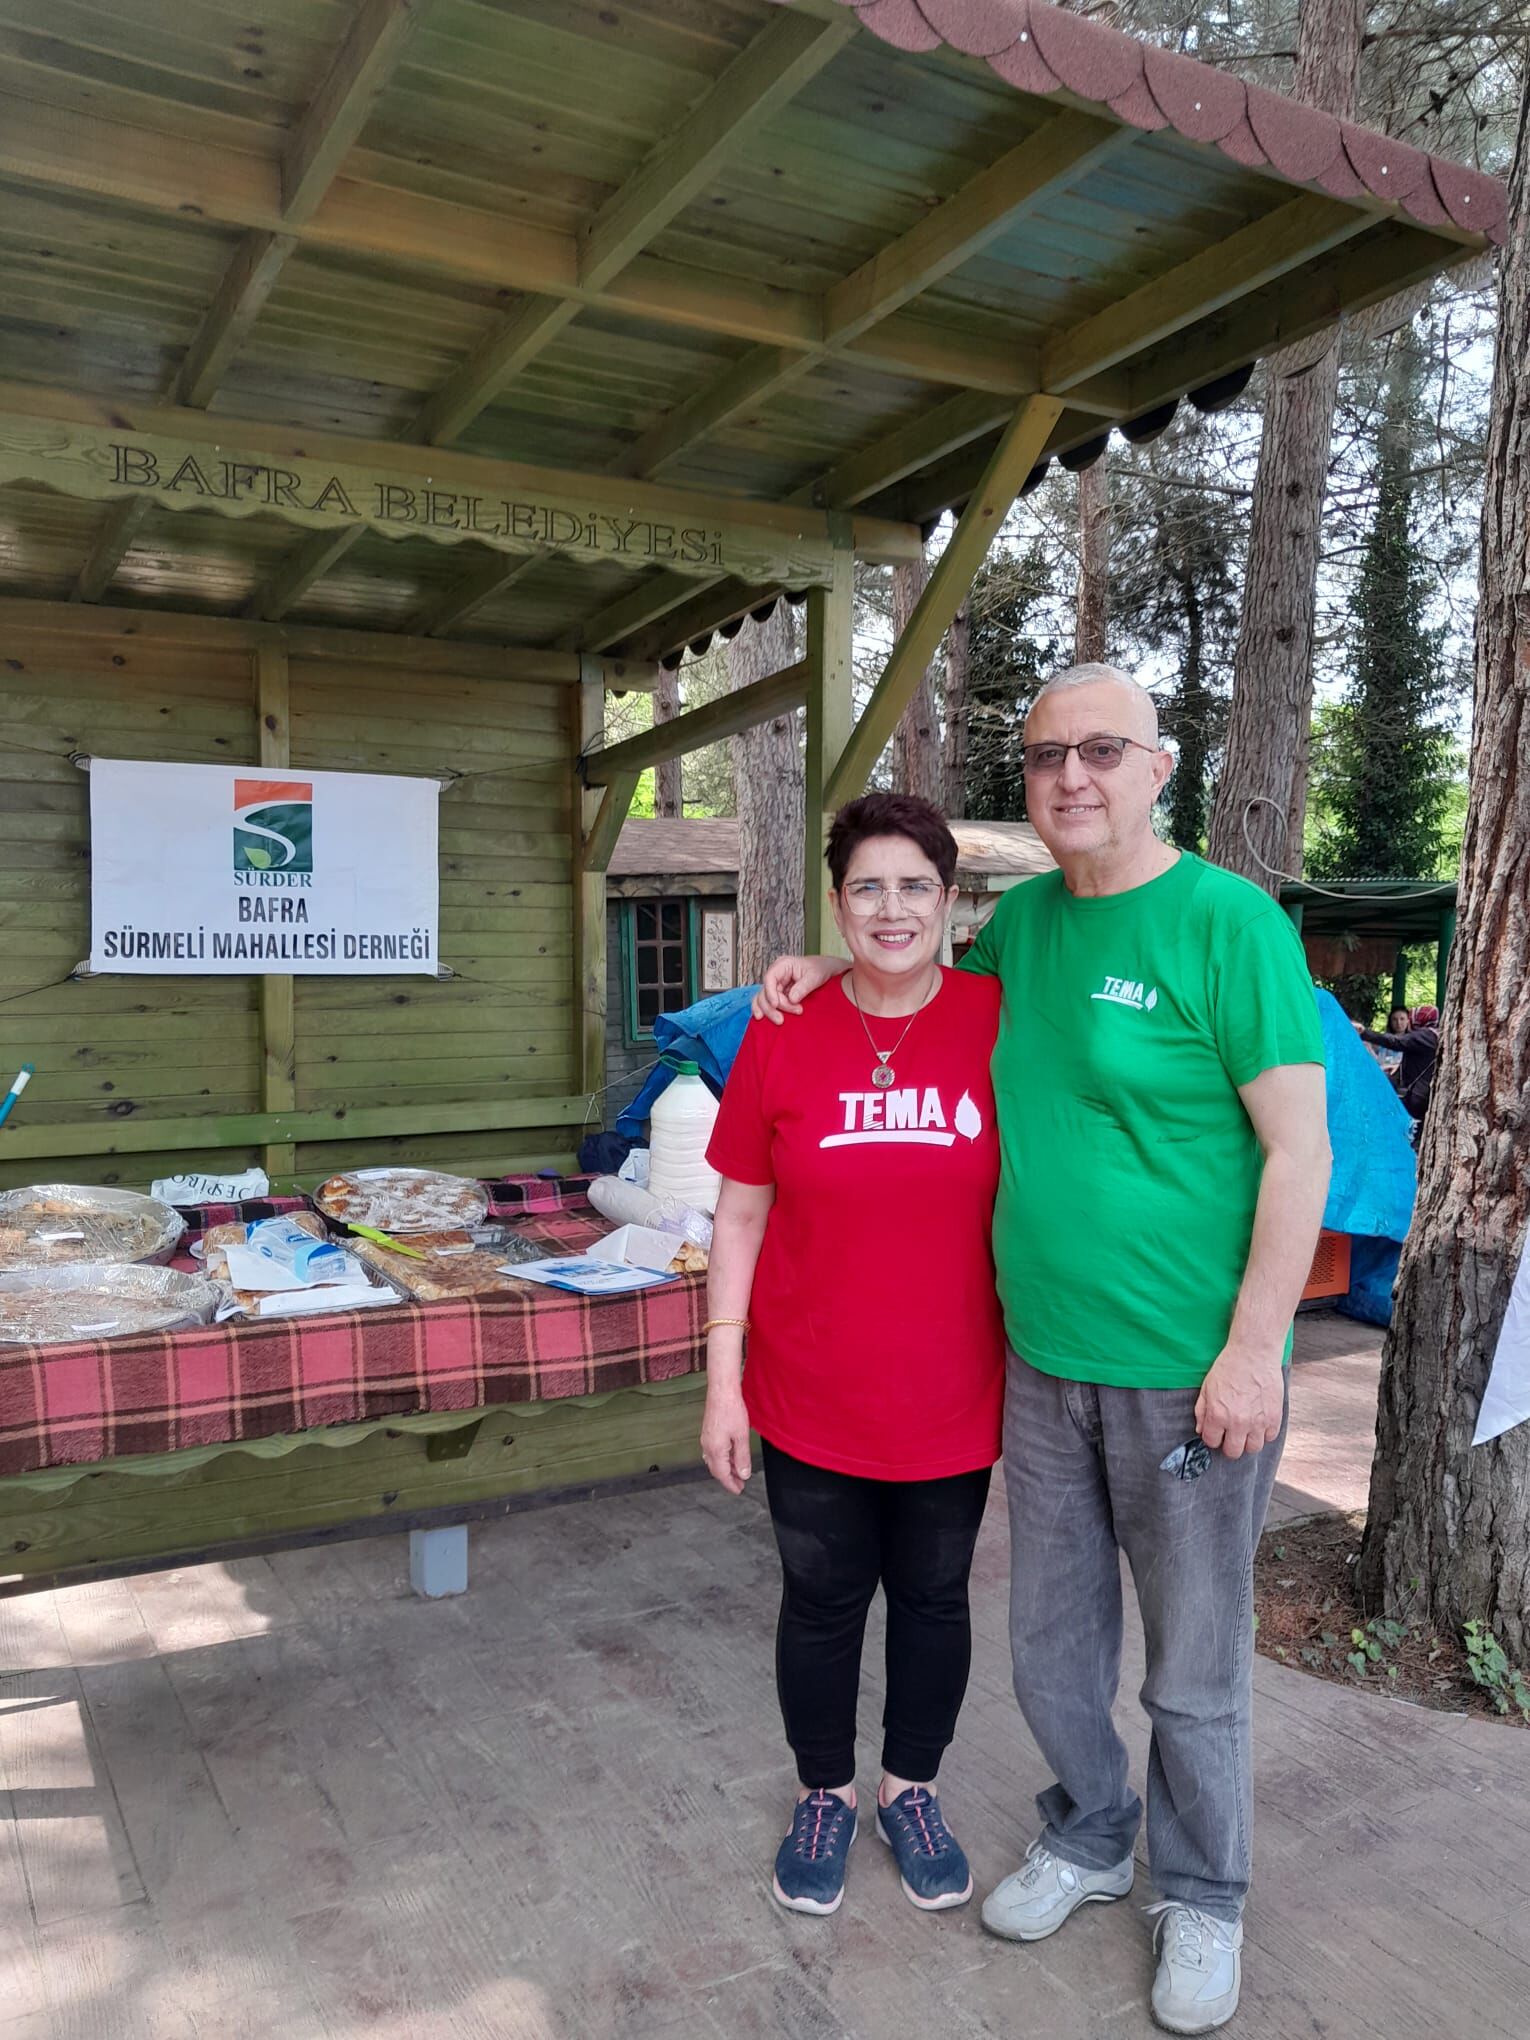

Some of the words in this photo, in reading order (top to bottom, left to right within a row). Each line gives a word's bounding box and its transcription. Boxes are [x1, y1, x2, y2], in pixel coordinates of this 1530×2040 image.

[109, 444, 362, 516] BAFRA
[233, 868, 313, 888] SÜRDER
[238, 896, 309, 923] BAFRA
[104, 925, 205, 959] SÜRMELİ
[213, 928, 336, 959] MAHALLESİ
[344, 928, 430, 959] DERNEĞİ
[1104, 976, 1145, 1002] TEMA
[838, 1087, 947, 1131] TEMA
